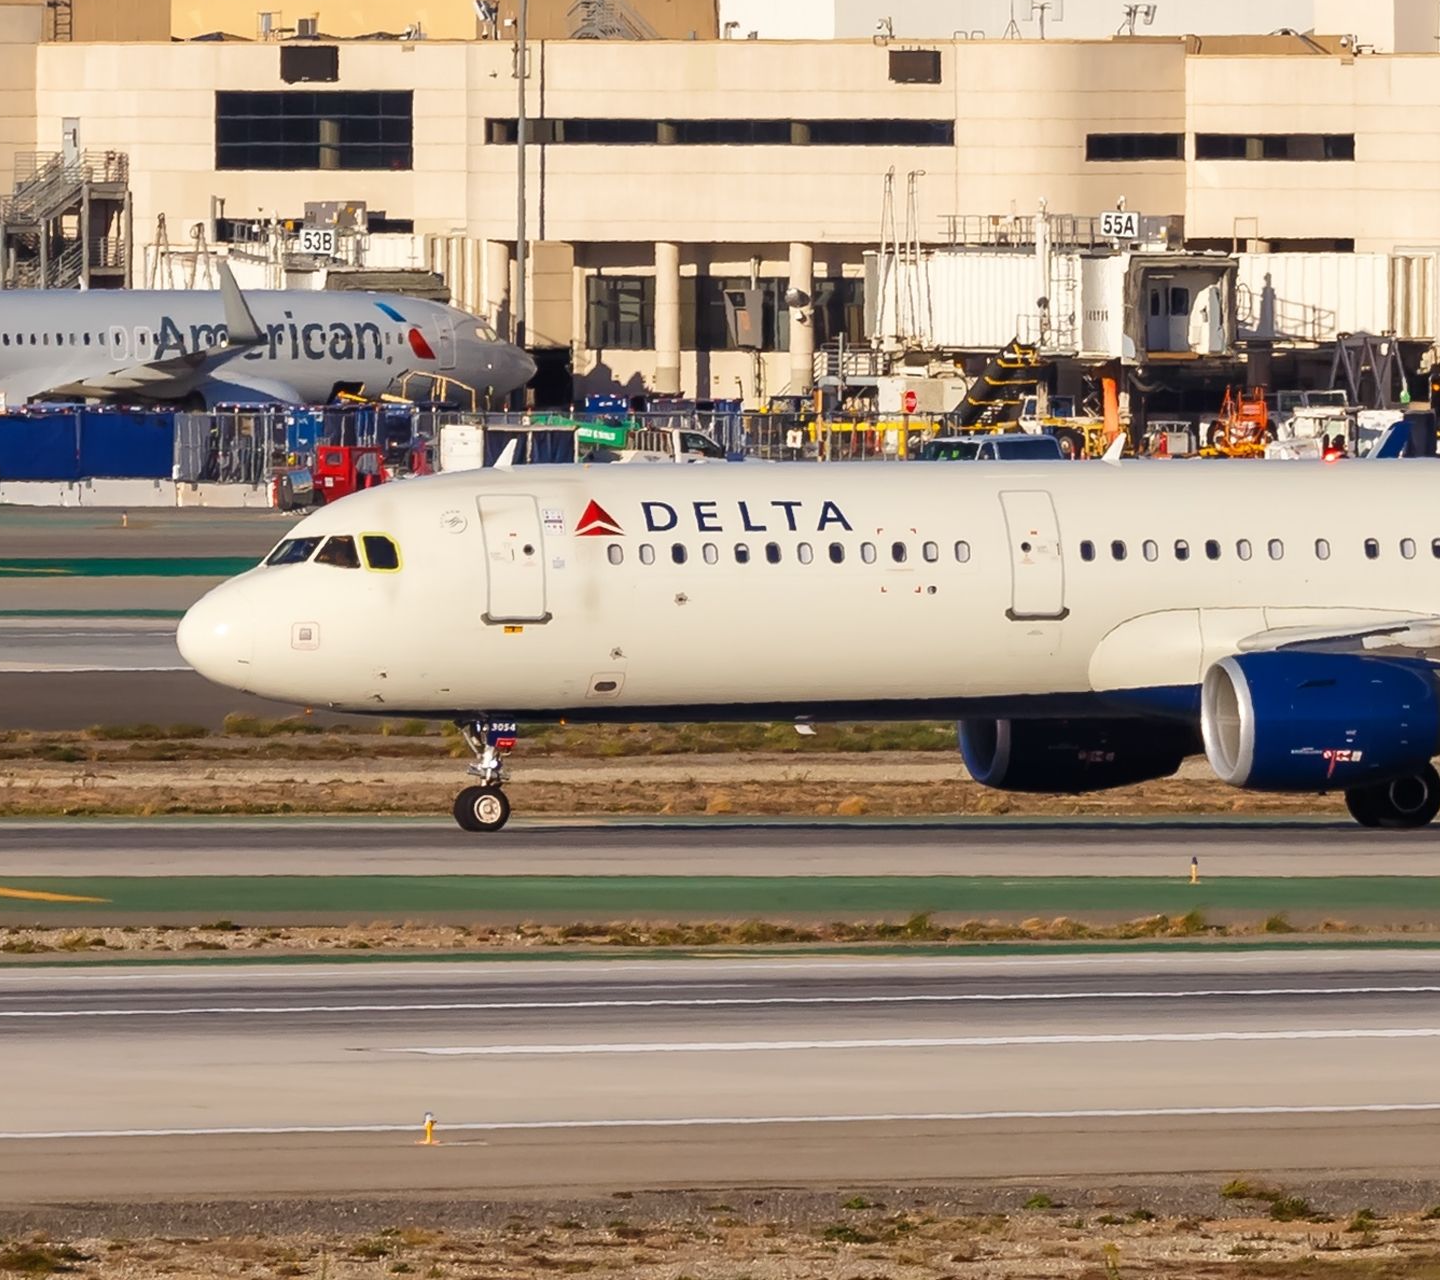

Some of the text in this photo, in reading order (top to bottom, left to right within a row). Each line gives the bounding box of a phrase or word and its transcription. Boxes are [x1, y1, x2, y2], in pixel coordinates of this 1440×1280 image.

[1103, 215, 1135, 235] 55A
[303, 232, 333, 251] 53B
[154, 311, 383, 361] Amrican
[641, 501, 853, 532] DELTA
[490, 723, 516, 732] 3054
